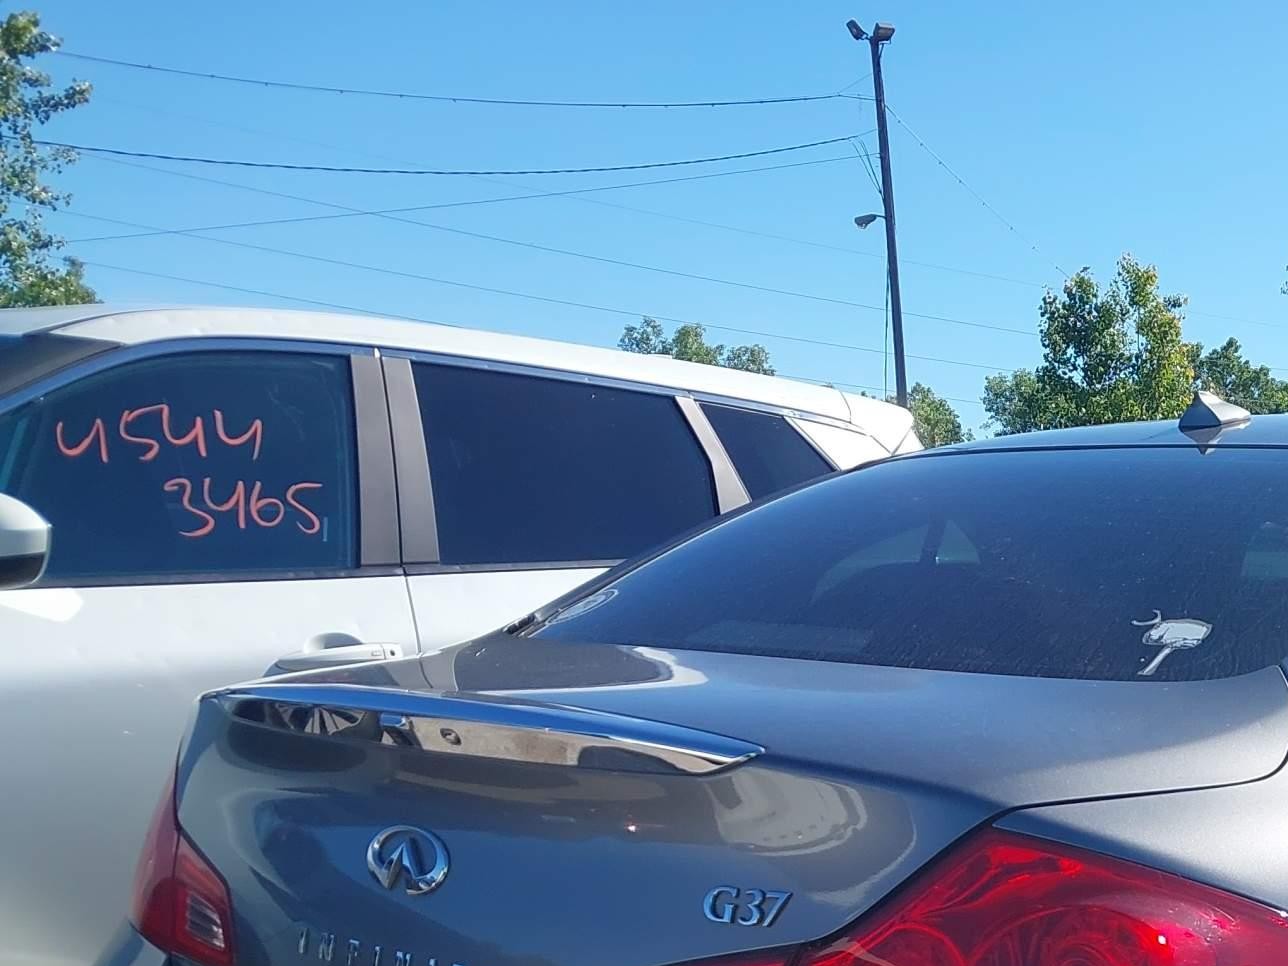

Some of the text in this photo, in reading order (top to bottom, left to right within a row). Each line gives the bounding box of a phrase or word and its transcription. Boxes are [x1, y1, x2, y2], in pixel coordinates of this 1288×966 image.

[56, 403, 263, 463] 4544
[163, 476, 323, 537] 3465
[702, 884, 794, 928] G37
